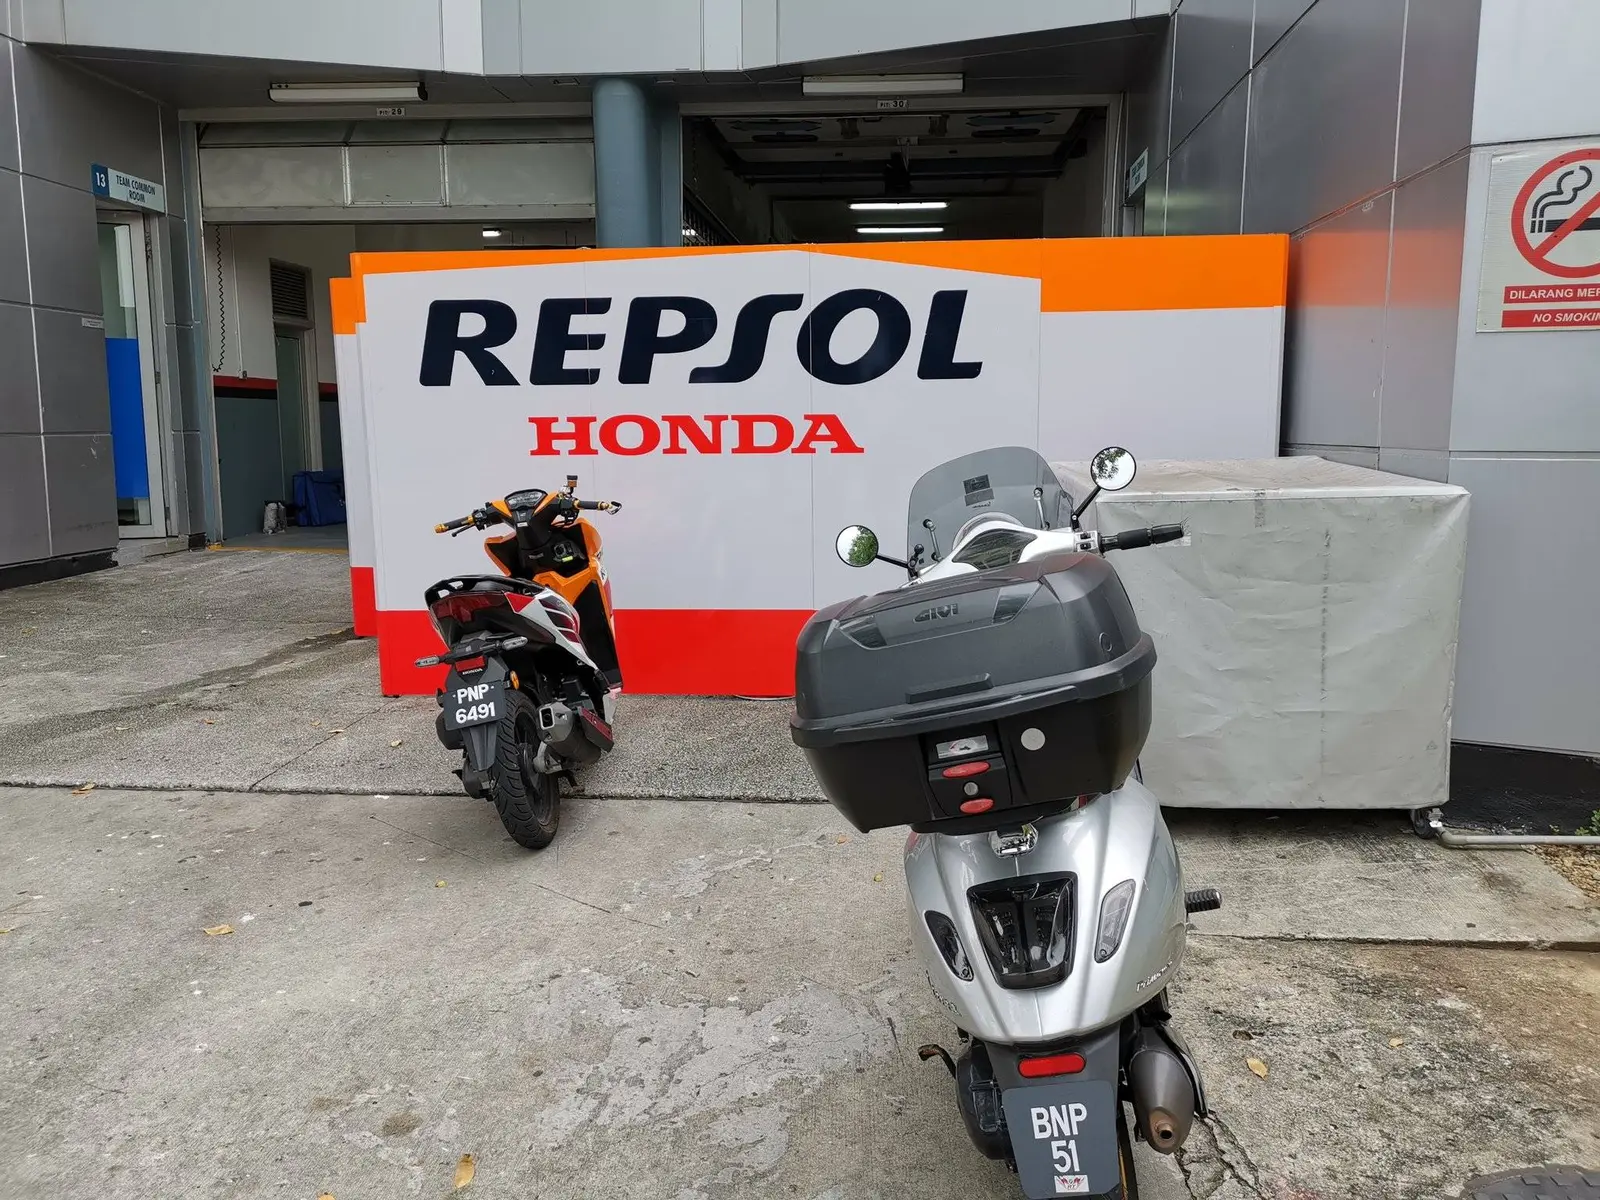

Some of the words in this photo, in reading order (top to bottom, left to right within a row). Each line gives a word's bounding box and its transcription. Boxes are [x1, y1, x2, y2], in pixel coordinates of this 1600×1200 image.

[893, 100, 904, 108] 30
[96, 172, 106, 187] 13
[116, 175, 130, 188] TEAM
[131, 180, 156, 195] COMMON
[129, 190, 146, 203] ROOM
[1510, 288, 1573, 299] DILARANG
[1532, 313, 1552, 323] NO
[419, 288, 983, 387] REPSOL
[528, 414, 865, 457] HONDA
[912, 603, 958, 623] GIVI
[456, 683, 489, 704] PNP
[455, 701, 496, 724] 6491
[1031, 1103, 1087, 1139] BNP
[1051, 1140, 1080, 1173] 51
